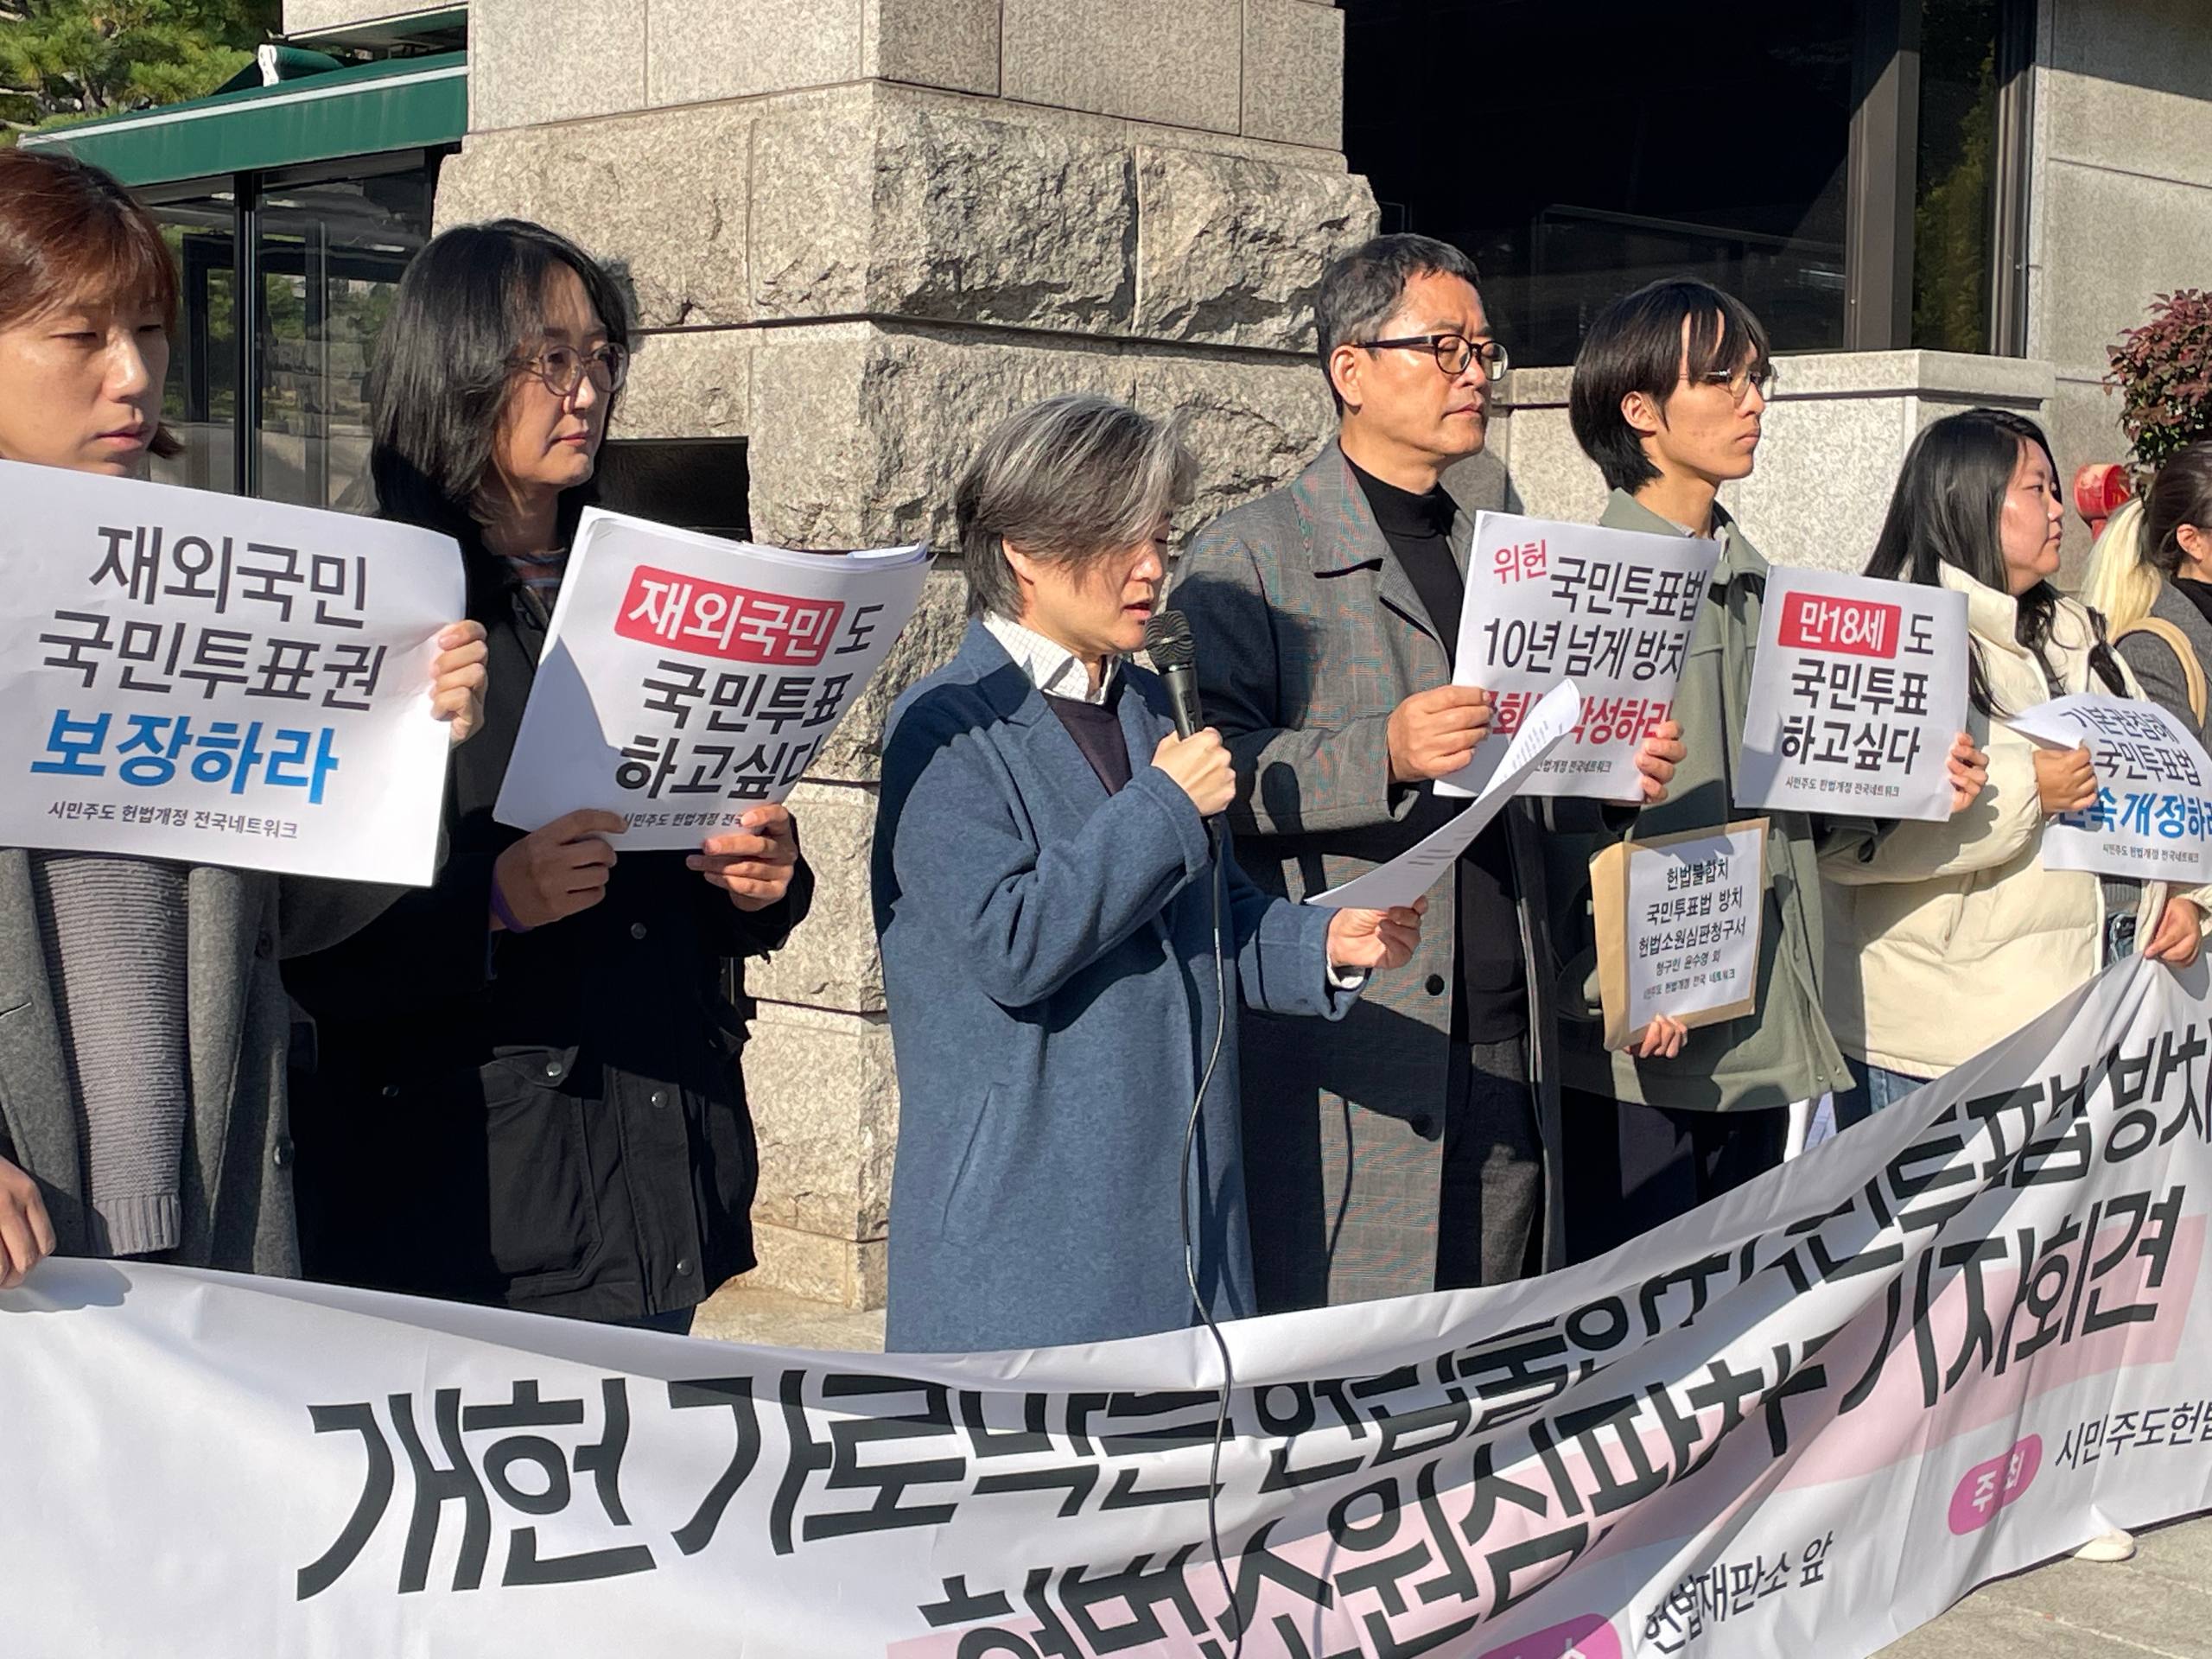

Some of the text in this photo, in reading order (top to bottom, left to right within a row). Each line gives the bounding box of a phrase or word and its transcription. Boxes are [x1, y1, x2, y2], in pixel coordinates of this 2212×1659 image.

[89, 525, 367, 629] 재외국민
[1493, 539, 1707, 622] 위헌 국민투표법
[628, 579, 885, 658] 재외국민 도
[1484, 618, 1692, 683] 10년 넘게 방치
[1799, 601, 1934, 655] 만18세 도
[39, 610, 388, 711] 국민투표권
[1791, 658, 1929, 715] 국민투표
[642, 659, 854, 734] 국민투표
[2059, 706, 2180, 744] 기본권침해
[30, 709, 339, 804] 보장하라
[615, 733, 823, 799] 하고싶다
[1782, 715, 1920, 775] 하고싶다
[2094, 739, 2202, 787] 국민투표법
[48, 801, 299, 839] 시민주도 헌법개정 전국네트워크
[672, 811, 721, 827] 헌법개정
[1646, 886, 1743, 927] 국민투표법 방치
[1666, 857, 1729, 892] 헌법불합치
[1639, 916, 1746, 959] 헌법소원심판청구서
[1837, 1185, 2187, 1417] 기자회견
[296, 1377, 658, 1601] 개헌
[666, 1369, 1236, 1556] 가로막는
[1645, 1530, 1833, 1654] 헌법재판소 앞
